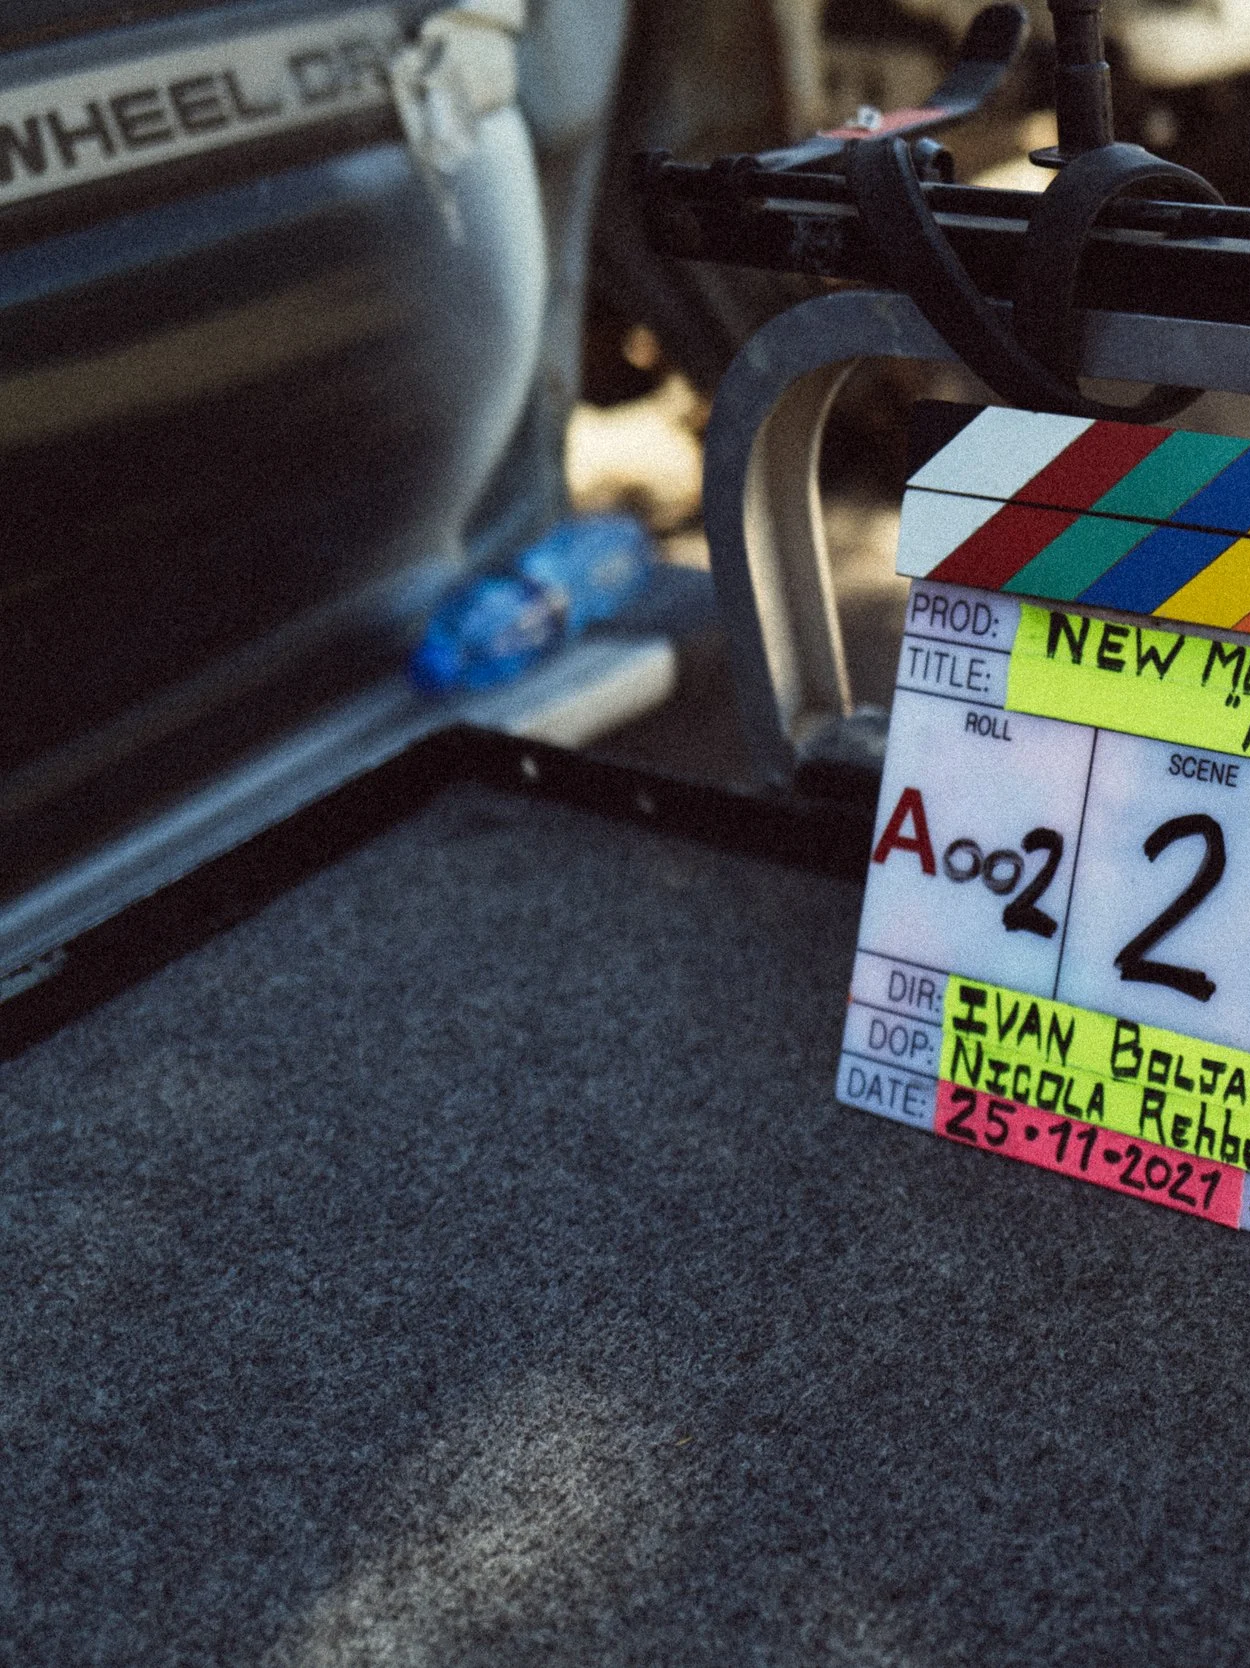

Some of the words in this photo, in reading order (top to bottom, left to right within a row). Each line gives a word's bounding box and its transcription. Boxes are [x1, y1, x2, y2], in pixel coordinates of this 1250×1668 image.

[0, 69, 283, 184] WHEEL
[911, 592, 1000, 638] PROD:
[908, 646, 991, 693] TITLE:
[1046, 611, 1186, 680] NEW
[964, 712, 1012, 742] ROLL
[1168, 753, 1240, 788] SCENE
[1113, 813, 1228, 1003] 2
[888, 969, 942, 1014] DIR:
[868, 1019, 935, 1065] DOP:
[951, 984, 1075, 1067] IVAN
[846, 1067, 927, 1119] DATE:
[949, 1035, 1105, 1122] NICOLA
